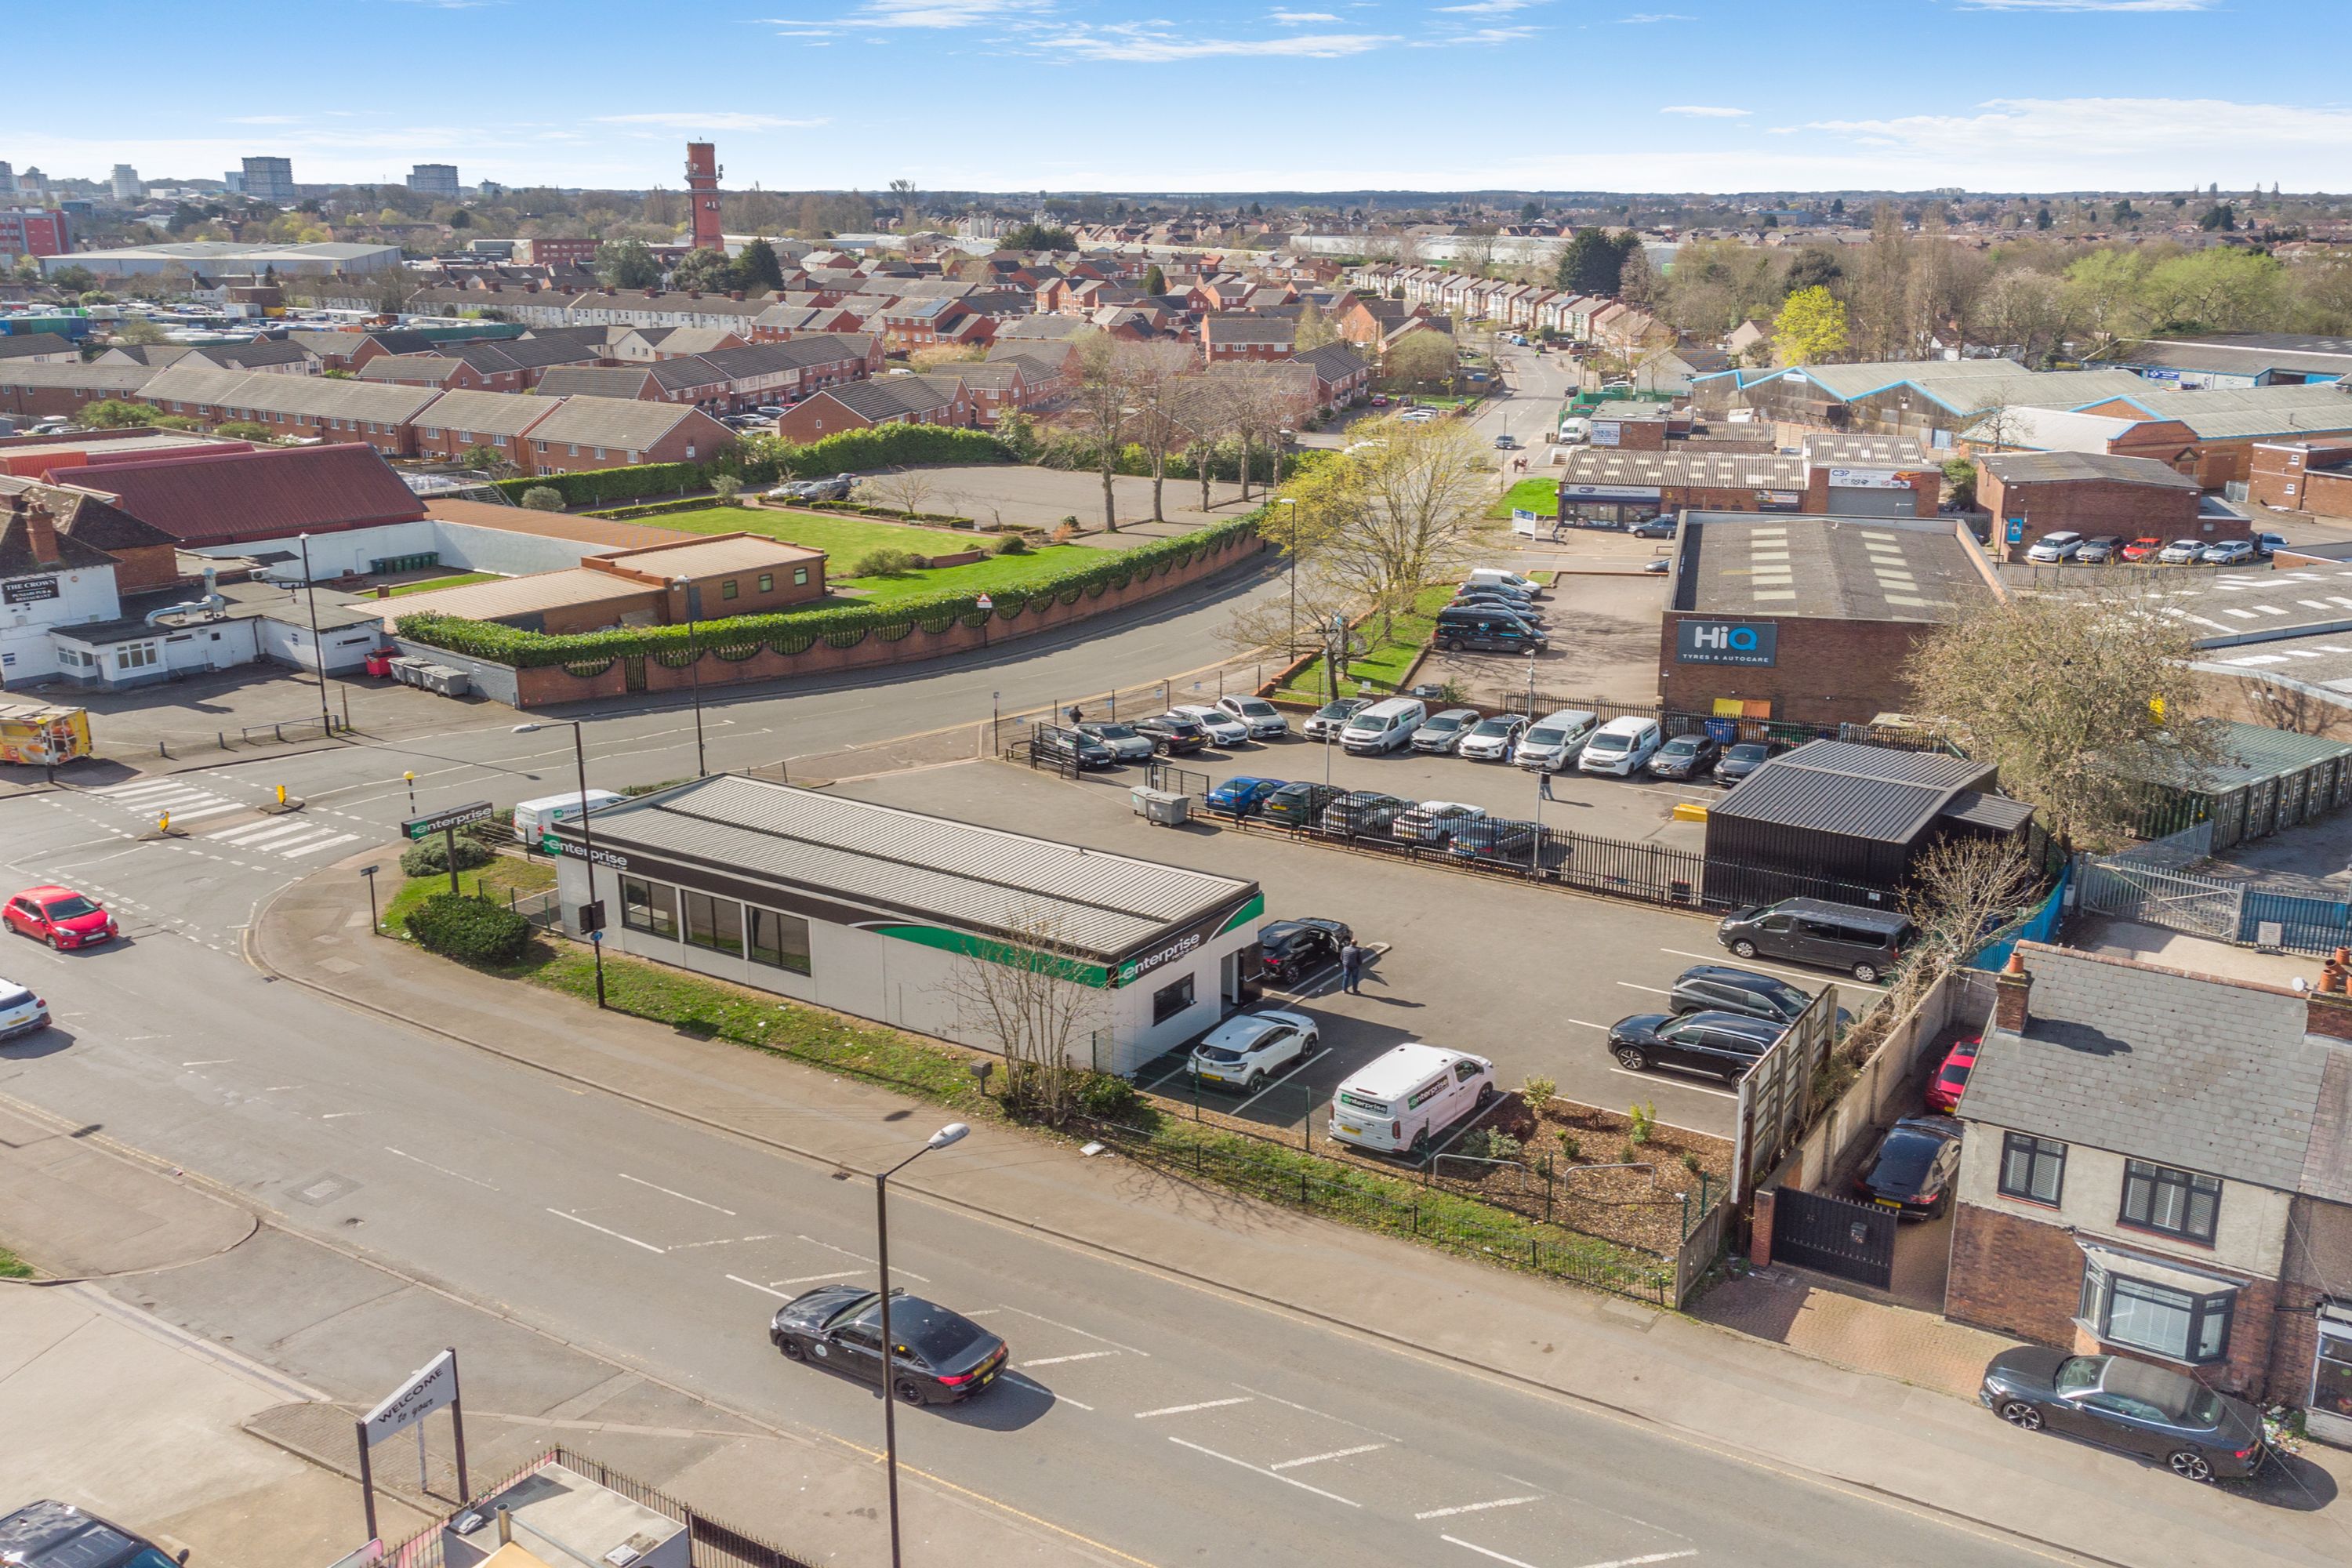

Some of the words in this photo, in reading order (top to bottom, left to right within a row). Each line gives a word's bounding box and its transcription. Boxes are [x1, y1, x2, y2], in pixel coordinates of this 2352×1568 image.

[24, 579, 55, 588] CROWN
[1694, 626, 1758, 651] HiQ
[411, 808, 492, 833] enterprise
[1120, 934, 1200, 980] enterprise
[1342, 1096, 1386, 1111] enterprise
[1409, 1079, 1448, 1105] enterprise
[379, 1368, 444, 1423] WELCOME
[412, 1399, 434, 1417] your
